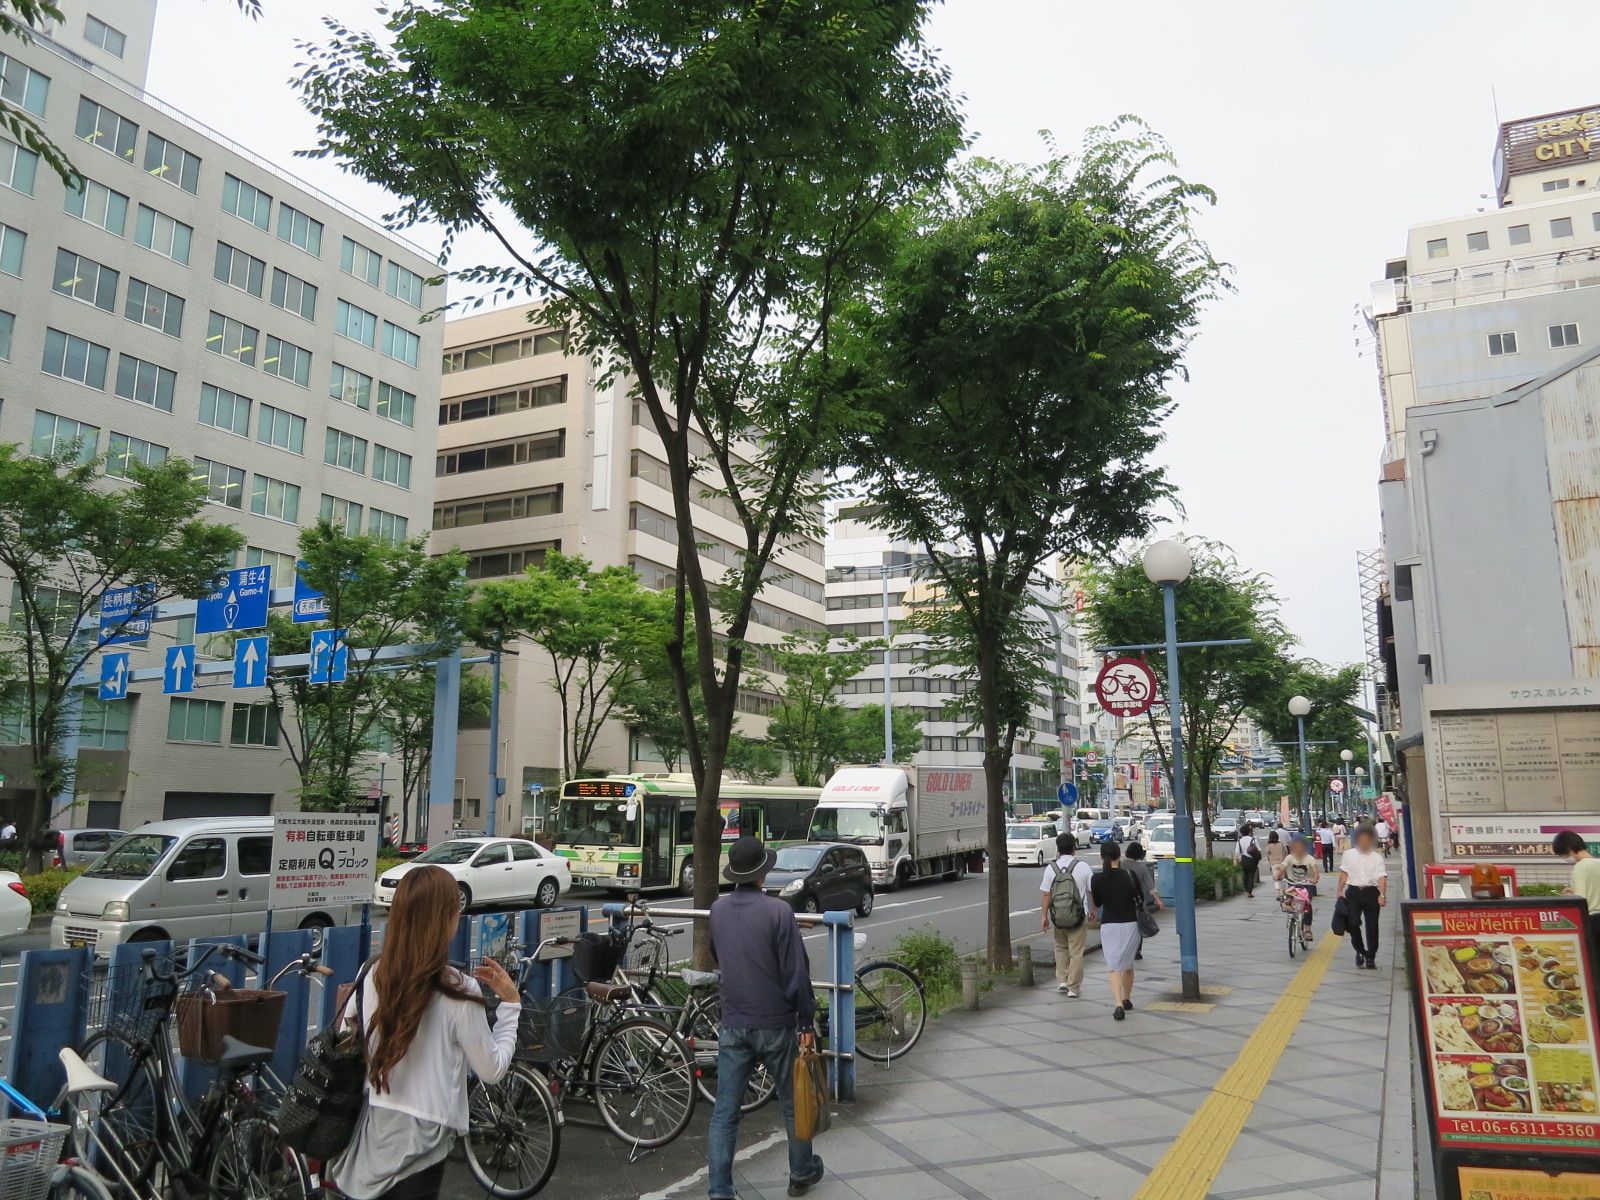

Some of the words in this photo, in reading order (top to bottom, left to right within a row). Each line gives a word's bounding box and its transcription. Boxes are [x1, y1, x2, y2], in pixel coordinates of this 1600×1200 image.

[1535, 136, 1592, 161] CITY
[239, 586, 263, 597] Gamo-4
[228, 607, 233, 619] 1
[926, 772, 949, 793] GOLD
[949, 772, 973, 791] LINER
[286, 830, 366, 842] 有料自転車駐車場
[1455, 844, 1475, 855] B1
[278, 858, 316, 871] 定期利用
[338, 858, 369, 868] ブロック
[1444, 911, 1468, 919] Indian
[1539, 911, 1560, 922] B1F
[1444, 918, 1477, 931] New
[1451, 1119, 1595, 1137] Tel.06-6311-5360
